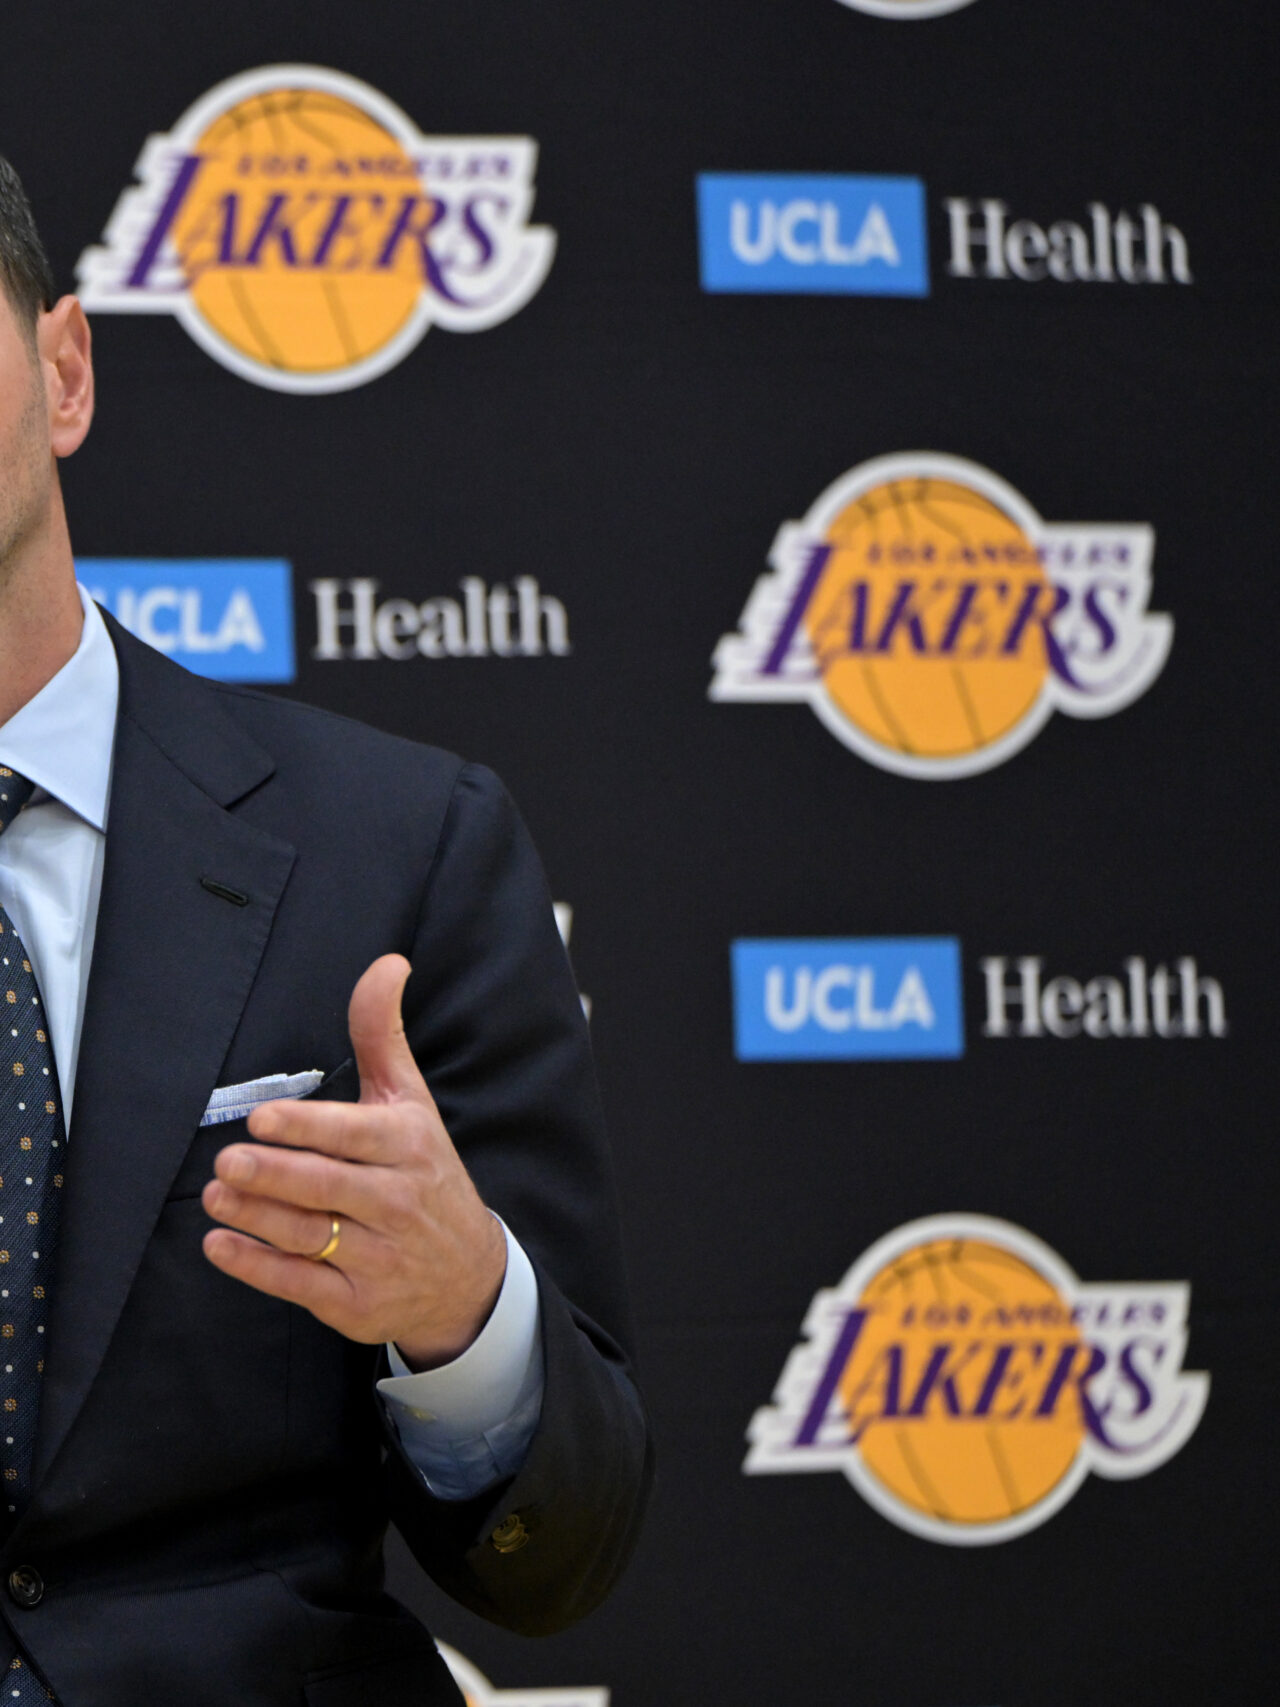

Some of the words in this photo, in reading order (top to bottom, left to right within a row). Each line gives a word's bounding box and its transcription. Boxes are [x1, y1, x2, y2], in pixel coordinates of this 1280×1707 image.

[237, 155, 309, 177] LOS
[325, 154, 513, 179] ANGELES
[105, 153, 535, 309] LAKERS
[730, 199, 900, 266] UCLA
[944, 197, 1194, 284] Health
[309, 575, 574, 660] Health
[738, 544, 1150, 693] LAKERS
[764, 963, 935, 1032] UCLA
[980, 956, 1230, 1037] Health
[902, 1304, 969, 1328] LOS
[982, 1302, 1167, 1328] ANGELES
[775, 1308, 1187, 1454] LAKERS
